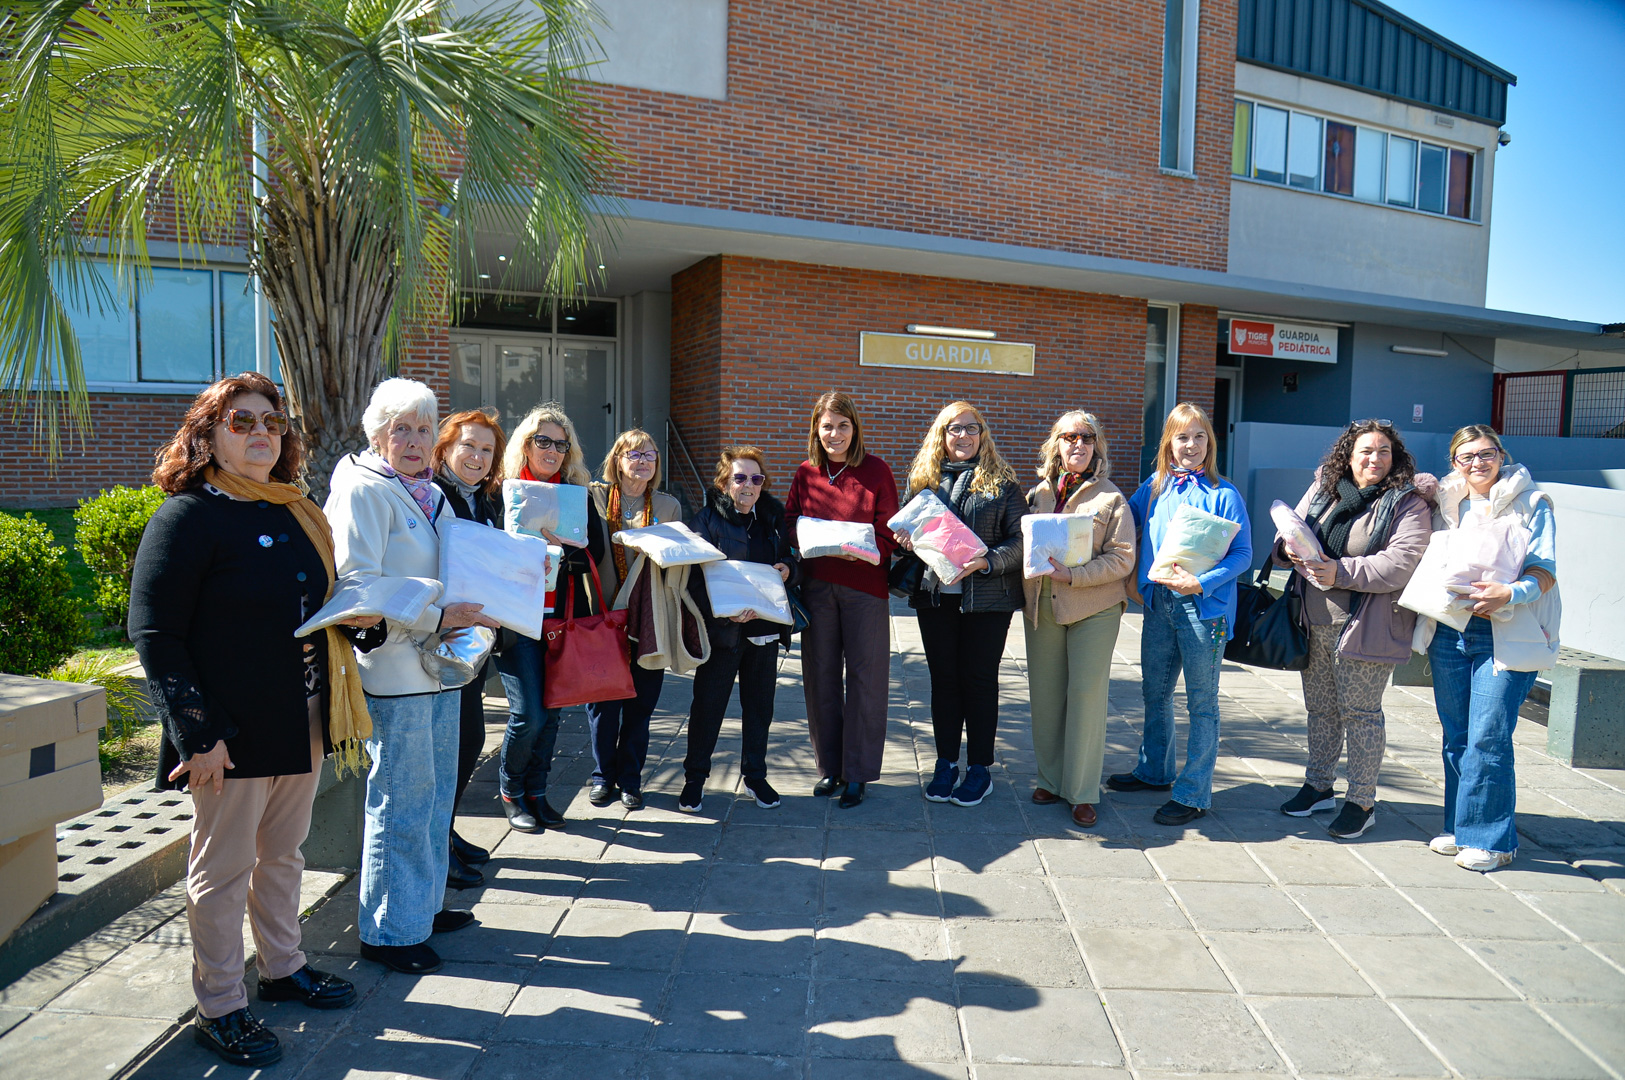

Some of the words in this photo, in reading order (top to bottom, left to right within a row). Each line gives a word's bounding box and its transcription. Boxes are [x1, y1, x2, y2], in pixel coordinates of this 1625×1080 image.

[1248, 332, 1268, 341] TIGRE
[1279, 329, 1319, 342] GUARDIA
[905, 342, 993, 365] GUARDIA
[1278, 341, 1331, 356] PEDIÁTRICA
